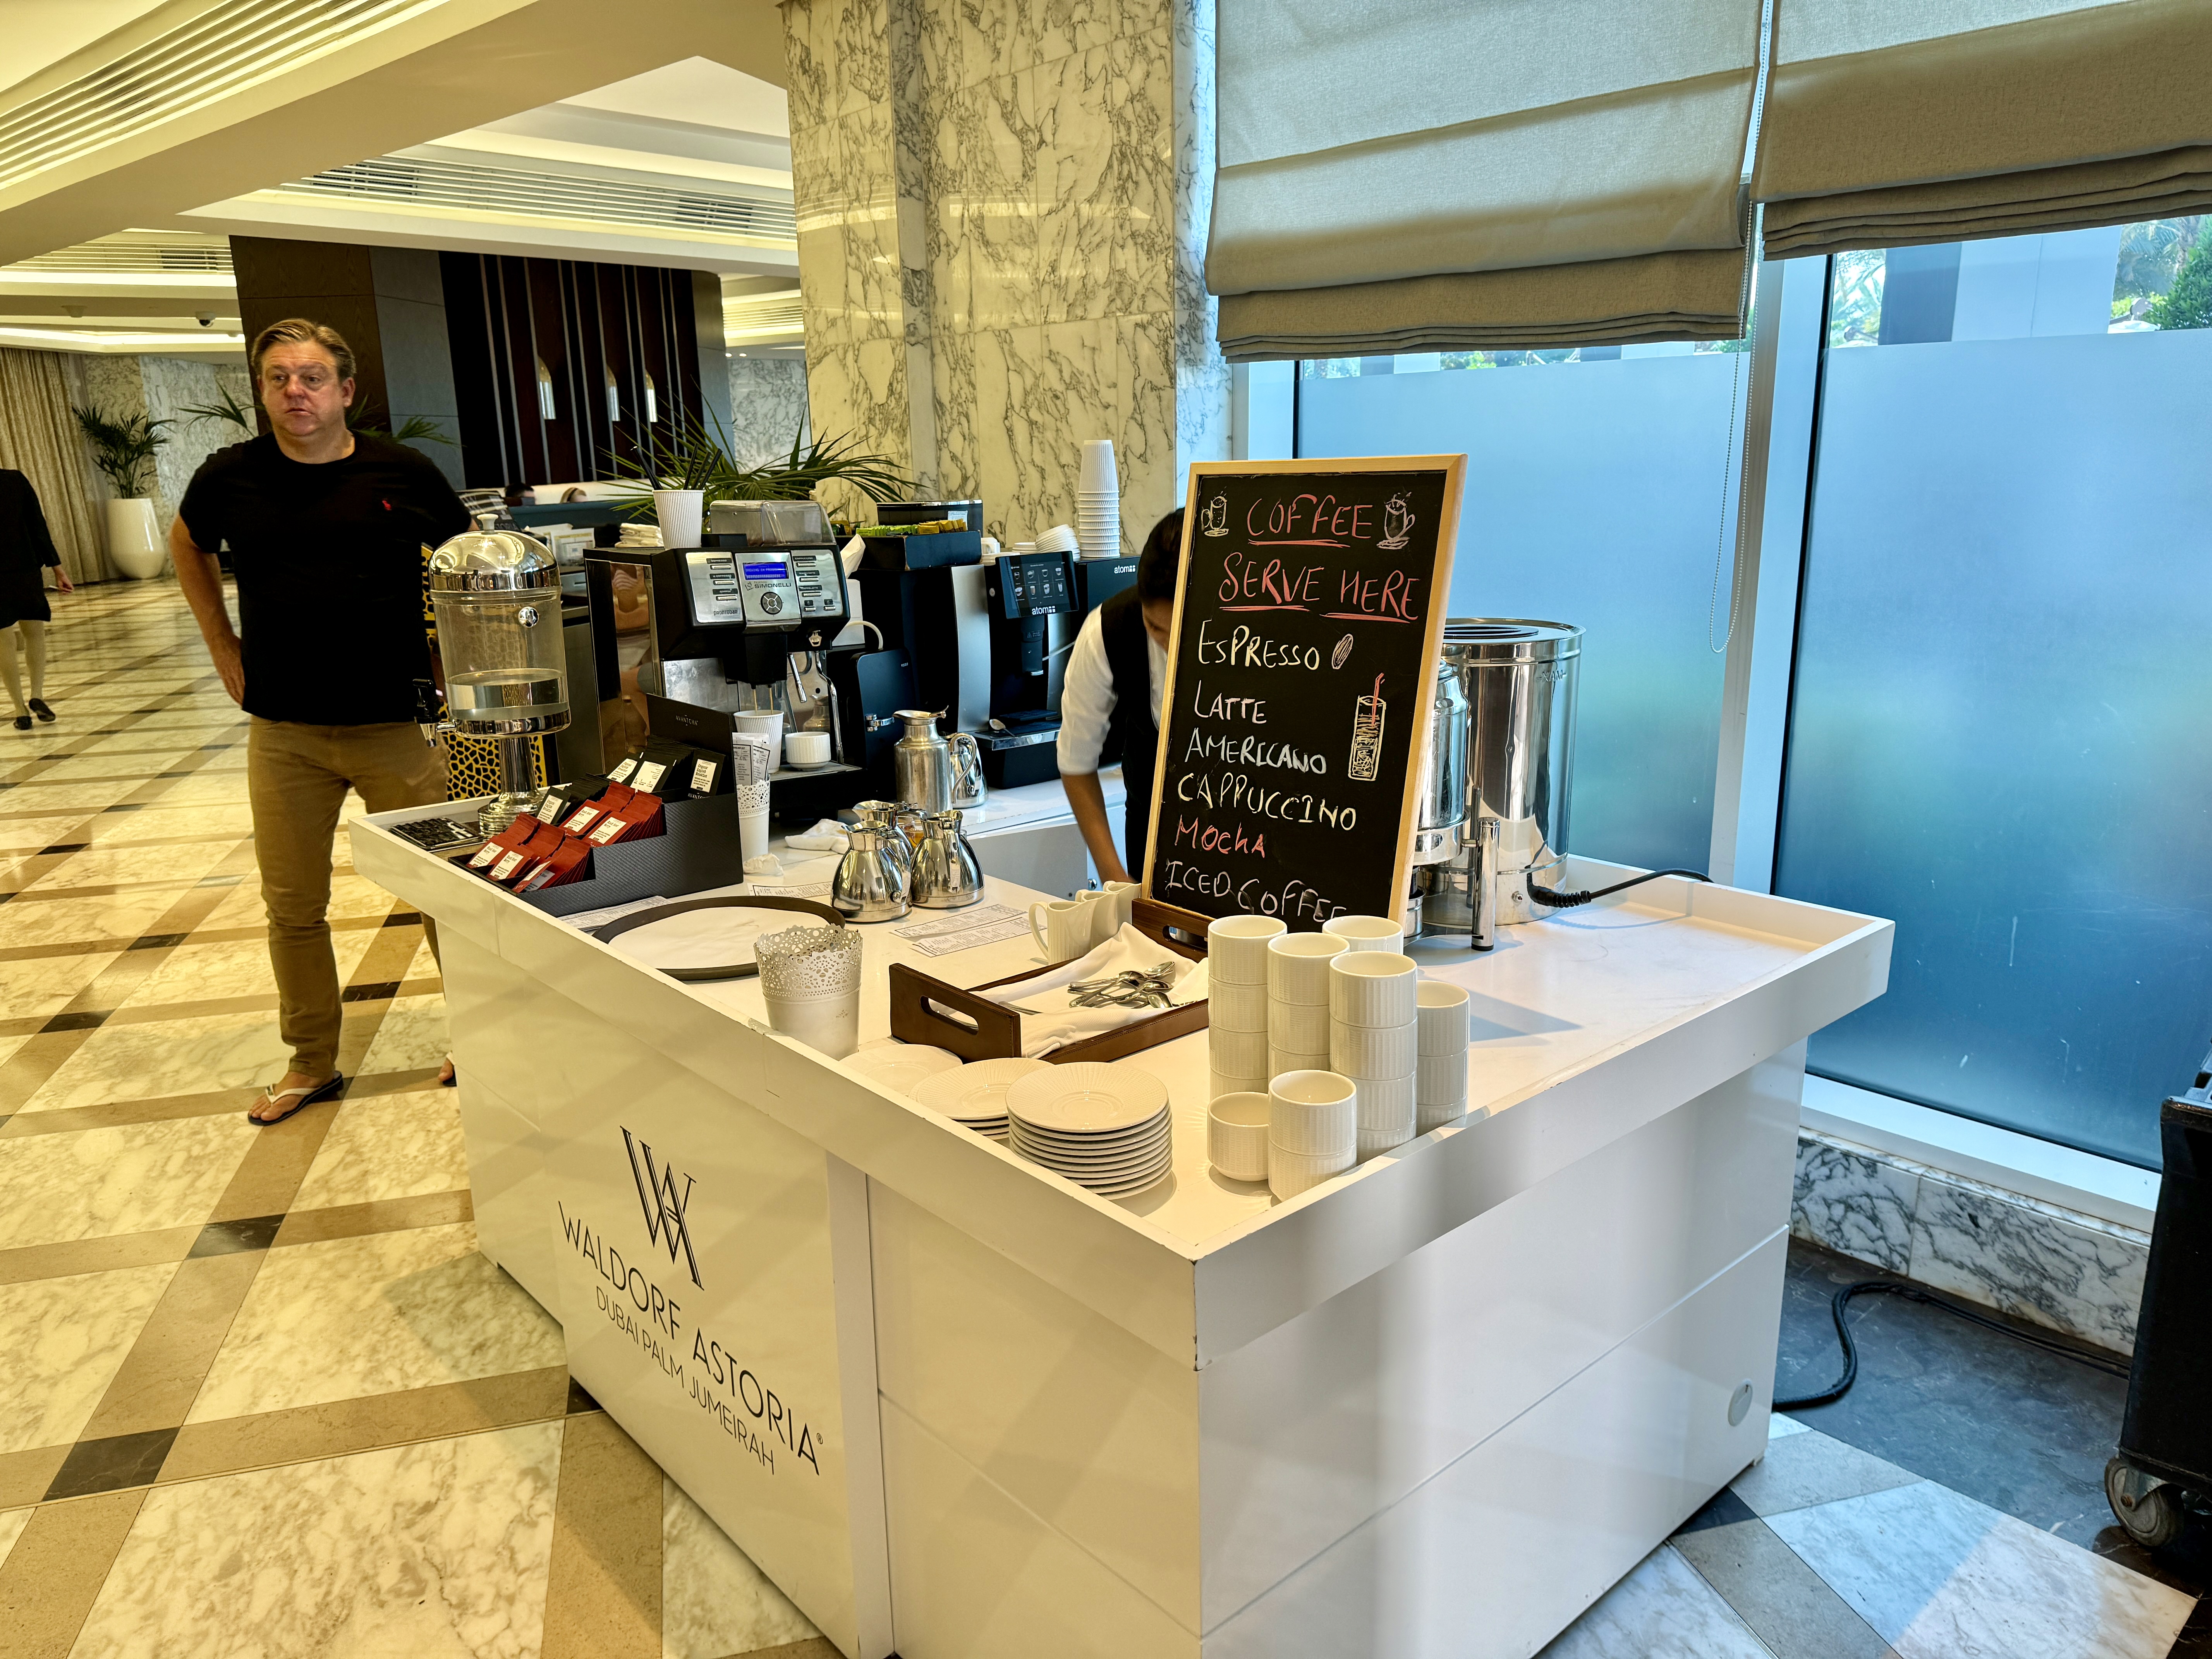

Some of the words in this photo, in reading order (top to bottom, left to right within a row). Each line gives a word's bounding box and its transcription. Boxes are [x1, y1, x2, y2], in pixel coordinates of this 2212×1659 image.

[1247, 494, 1373, 539] COFFEE
[1219, 552, 1324, 604] SERVE
[1341, 570, 1420, 620] HERE
[1199, 619, 1320, 670] ESPRESSO
[1194, 680, 1267, 724] LATTE
[1184, 727, 1327, 774] AMERICANO
[1178, 772, 1356, 831] CAPPUCCINO
[1165, 860, 1231, 897] ICED
[558, 1200, 681, 1340] WALDORF
[596, 1285, 639, 1345] DUBAI
[642, 1329, 684, 1389] PALM
[689, 1376, 775, 1475] JUMEIRAH
